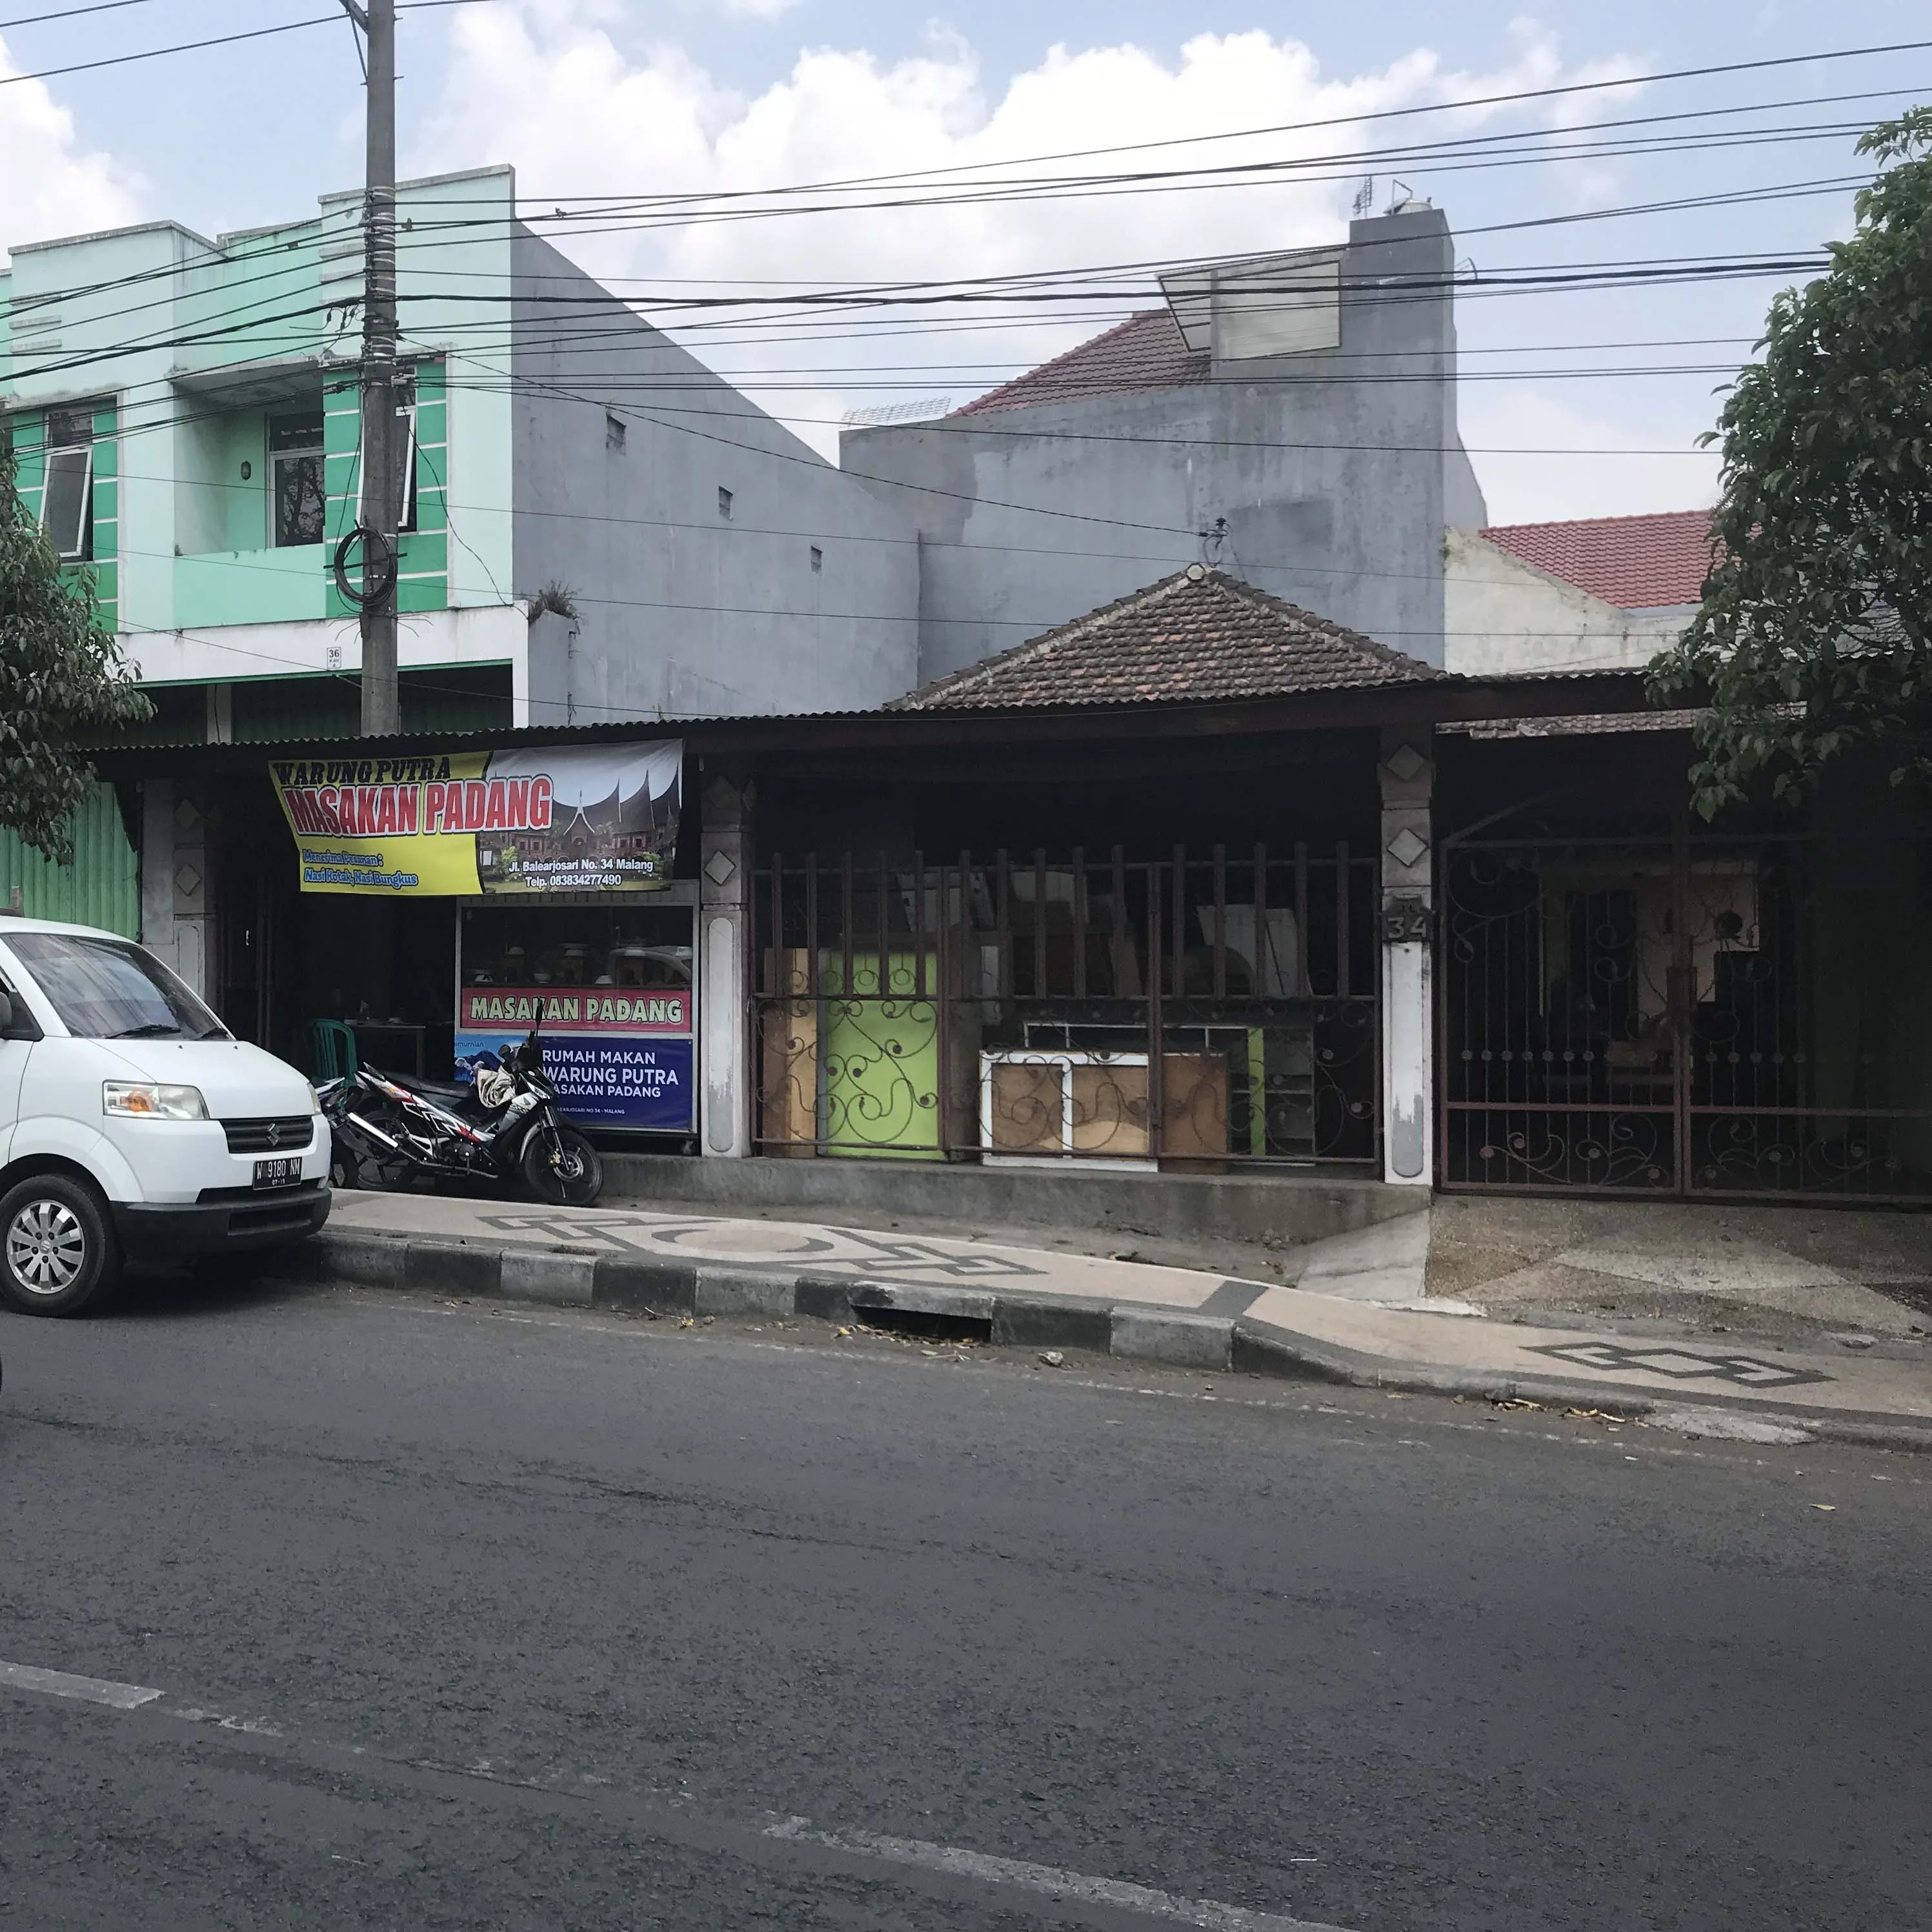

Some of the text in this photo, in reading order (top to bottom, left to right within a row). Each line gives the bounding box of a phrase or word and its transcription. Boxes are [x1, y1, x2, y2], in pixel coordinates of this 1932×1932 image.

[329, 649, 339, 658] 36
[273, 757, 451, 785] WARUNG PUTRA
[283, 774, 553, 838] MASAKAN PADANG
[303, 849, 343, 863] Menerima
[508, 858, 654, 873] Jl. Balearjosari No. 34 Malang
[305, 868, 325, 883] Nasi
[354, 870, 374, 885] Nasi
[374, 870, 418, 890] Bungkus
[525, 874, 621, 889] Telp. 083834277490
[1387, 916, 1426, 938] 34
[585, 998, 683, 1023] PADANG
[542, 1050, 656, 1065] RUMAH MAKAN
[543, 1066, 679, 1085] WARUNG PUTRA
[554, 1083, 661, 1098] ASAKAN PADANG
[268, 1160, 287, 1178] 9180
[290, 1158, 300, 1176] NM
